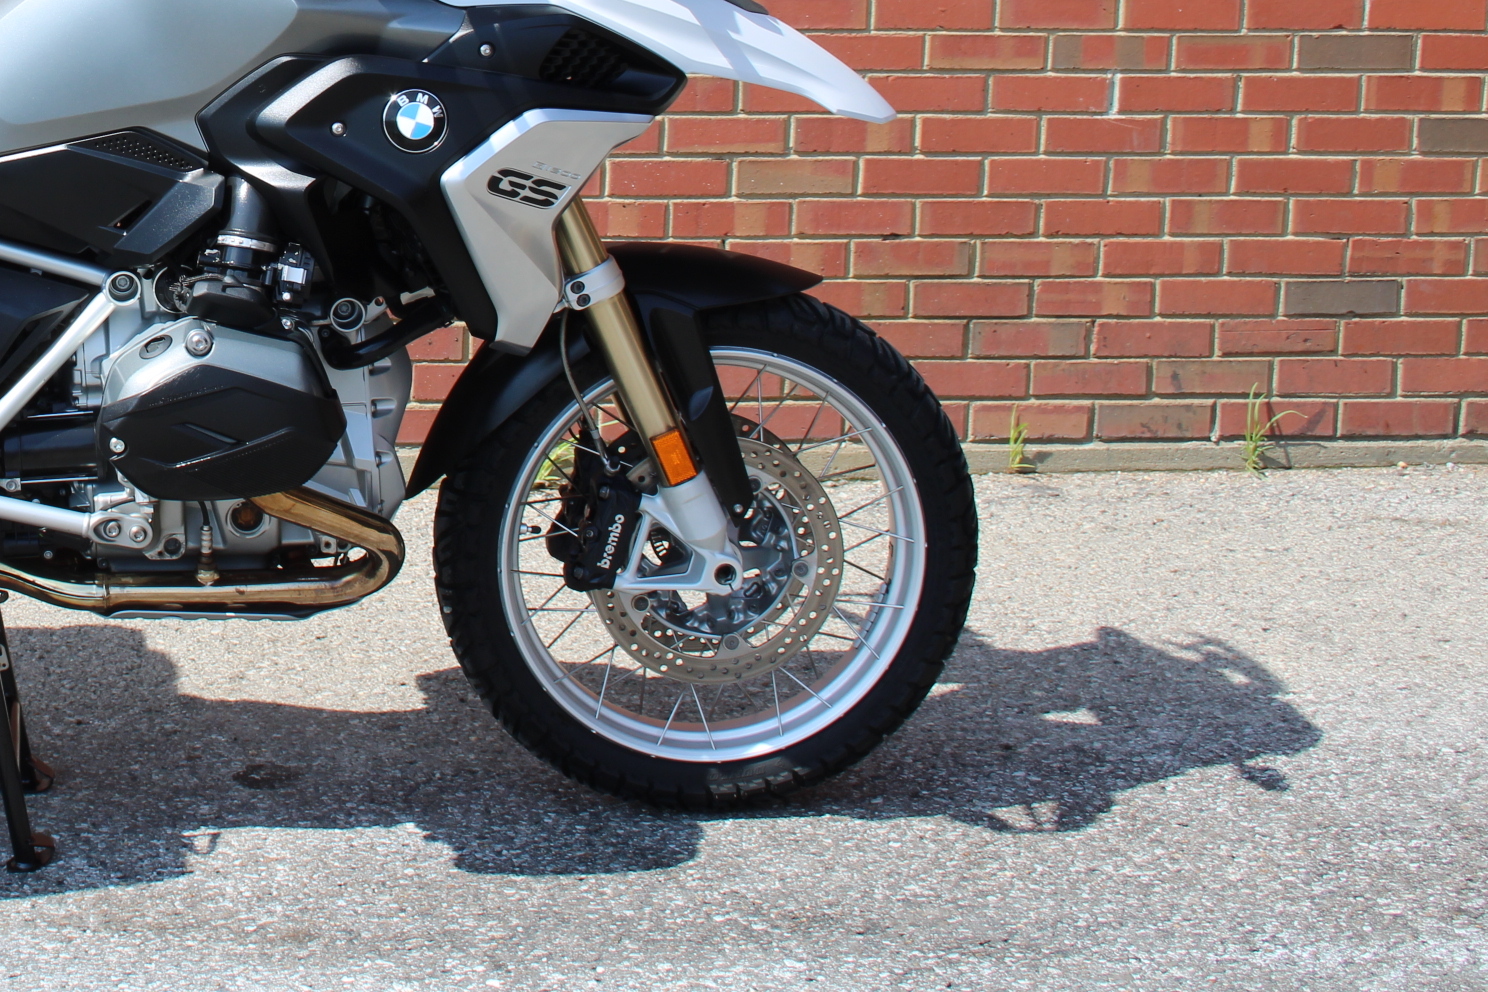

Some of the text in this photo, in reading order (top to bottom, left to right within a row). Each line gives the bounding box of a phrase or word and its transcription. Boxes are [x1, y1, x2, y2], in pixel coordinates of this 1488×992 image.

[396, 92, 444, 118] BMW
[486, 168, 567, 208] GS
[597, 513, 625, 570] brembo
